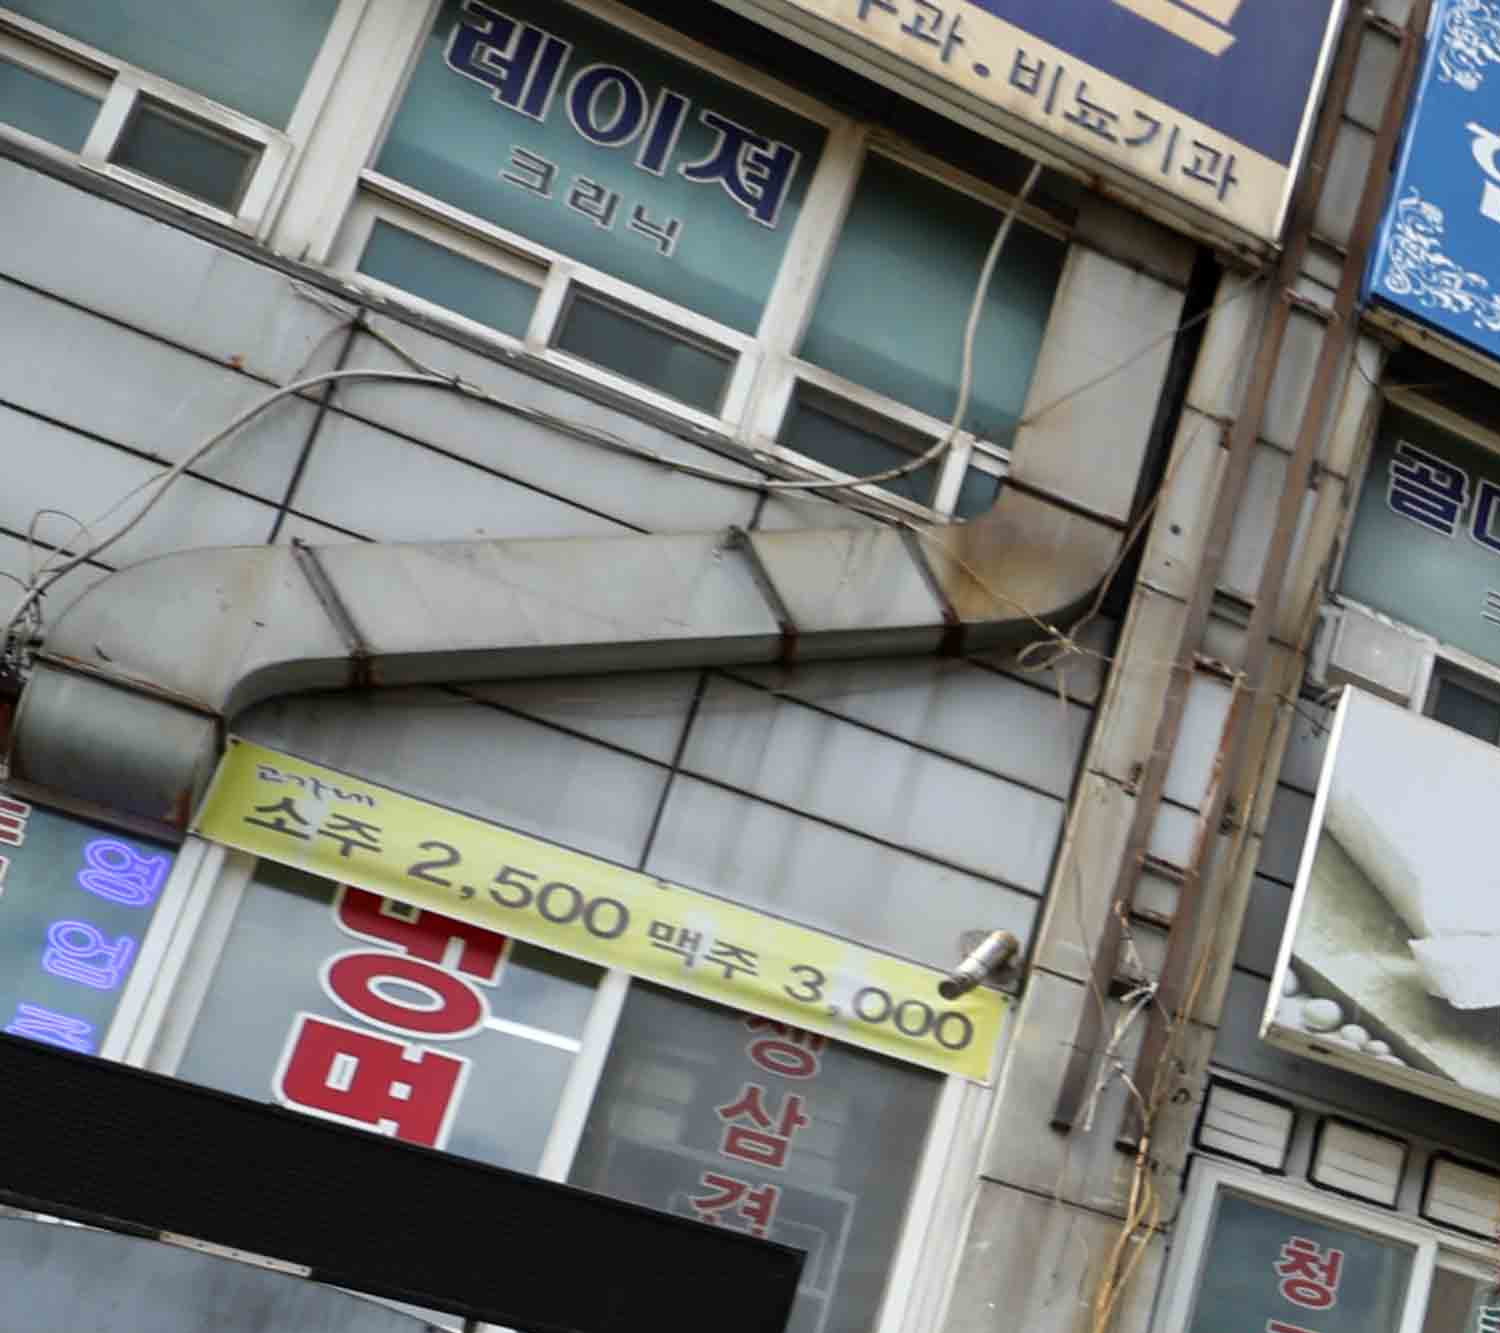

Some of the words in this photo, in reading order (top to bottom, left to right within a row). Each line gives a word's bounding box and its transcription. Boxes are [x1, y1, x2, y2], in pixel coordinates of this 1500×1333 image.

[443, 2, 800, 232] 레이져
[501, 147, 687, 257] 크리닉
[243, 797, 383, 857] 소주
[406, 839, 632, 942] 2,500
[646, 918, 761, 982] 맥주
[783, 962, 974, 1053] 3,000
